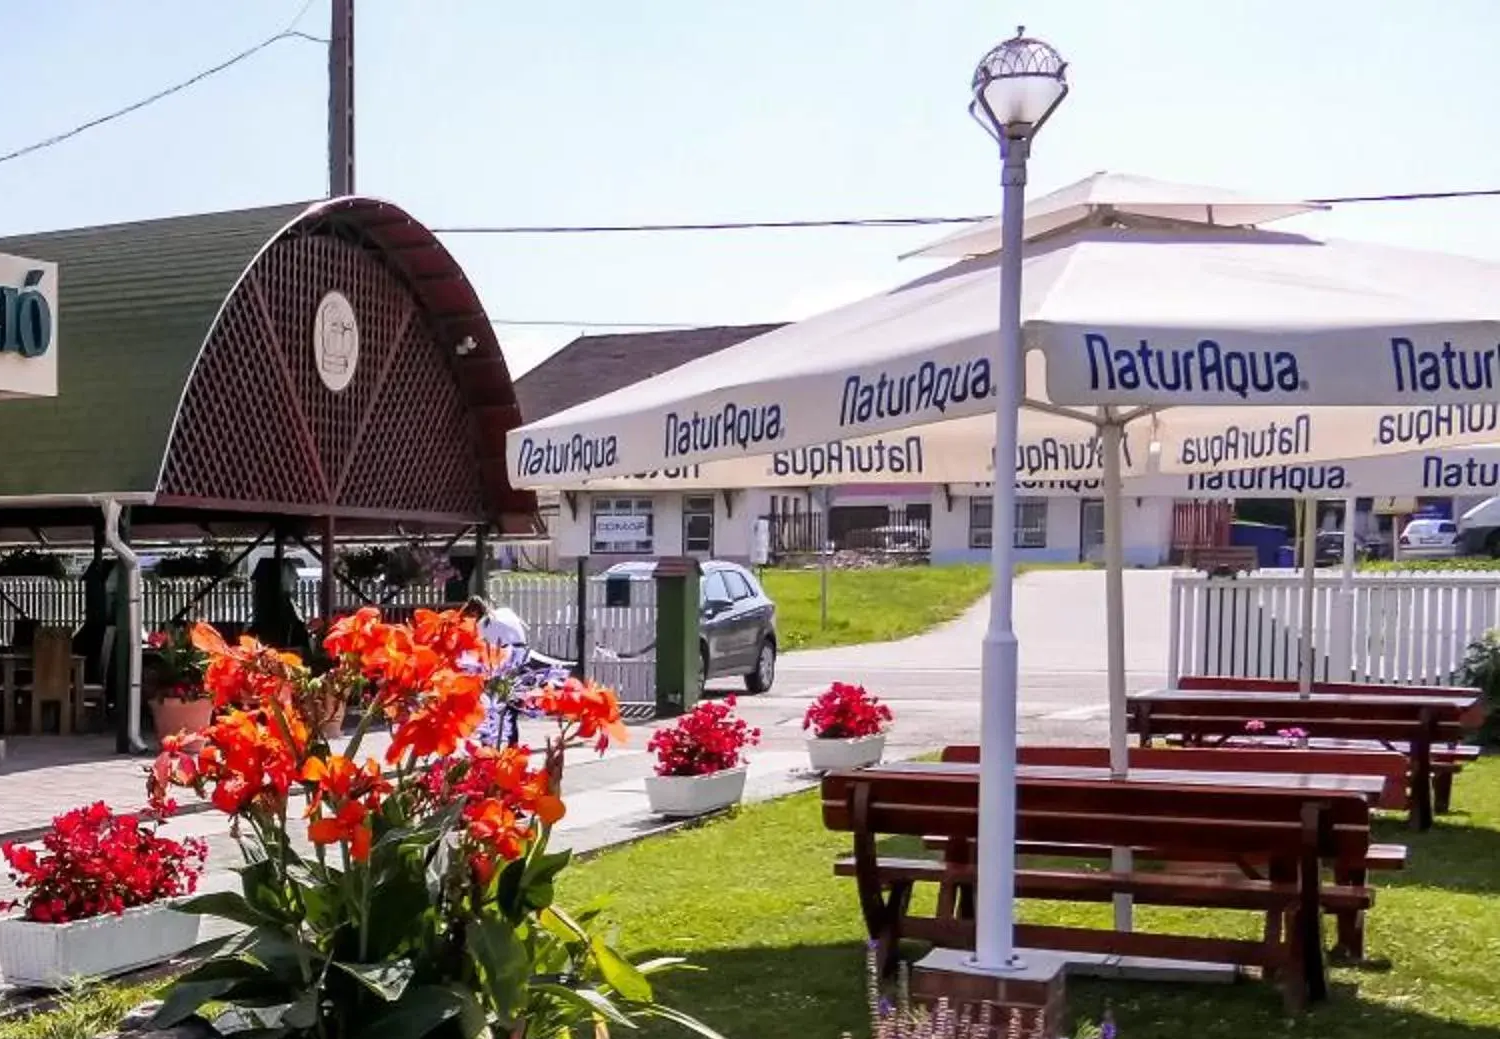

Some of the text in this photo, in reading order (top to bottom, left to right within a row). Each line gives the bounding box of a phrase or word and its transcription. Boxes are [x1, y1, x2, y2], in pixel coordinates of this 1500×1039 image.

[1084, 333, 1500, 398] NaturAqua Natur
[518, 358, 992, 477] NaturAqua NaturAqua NaturAqua
